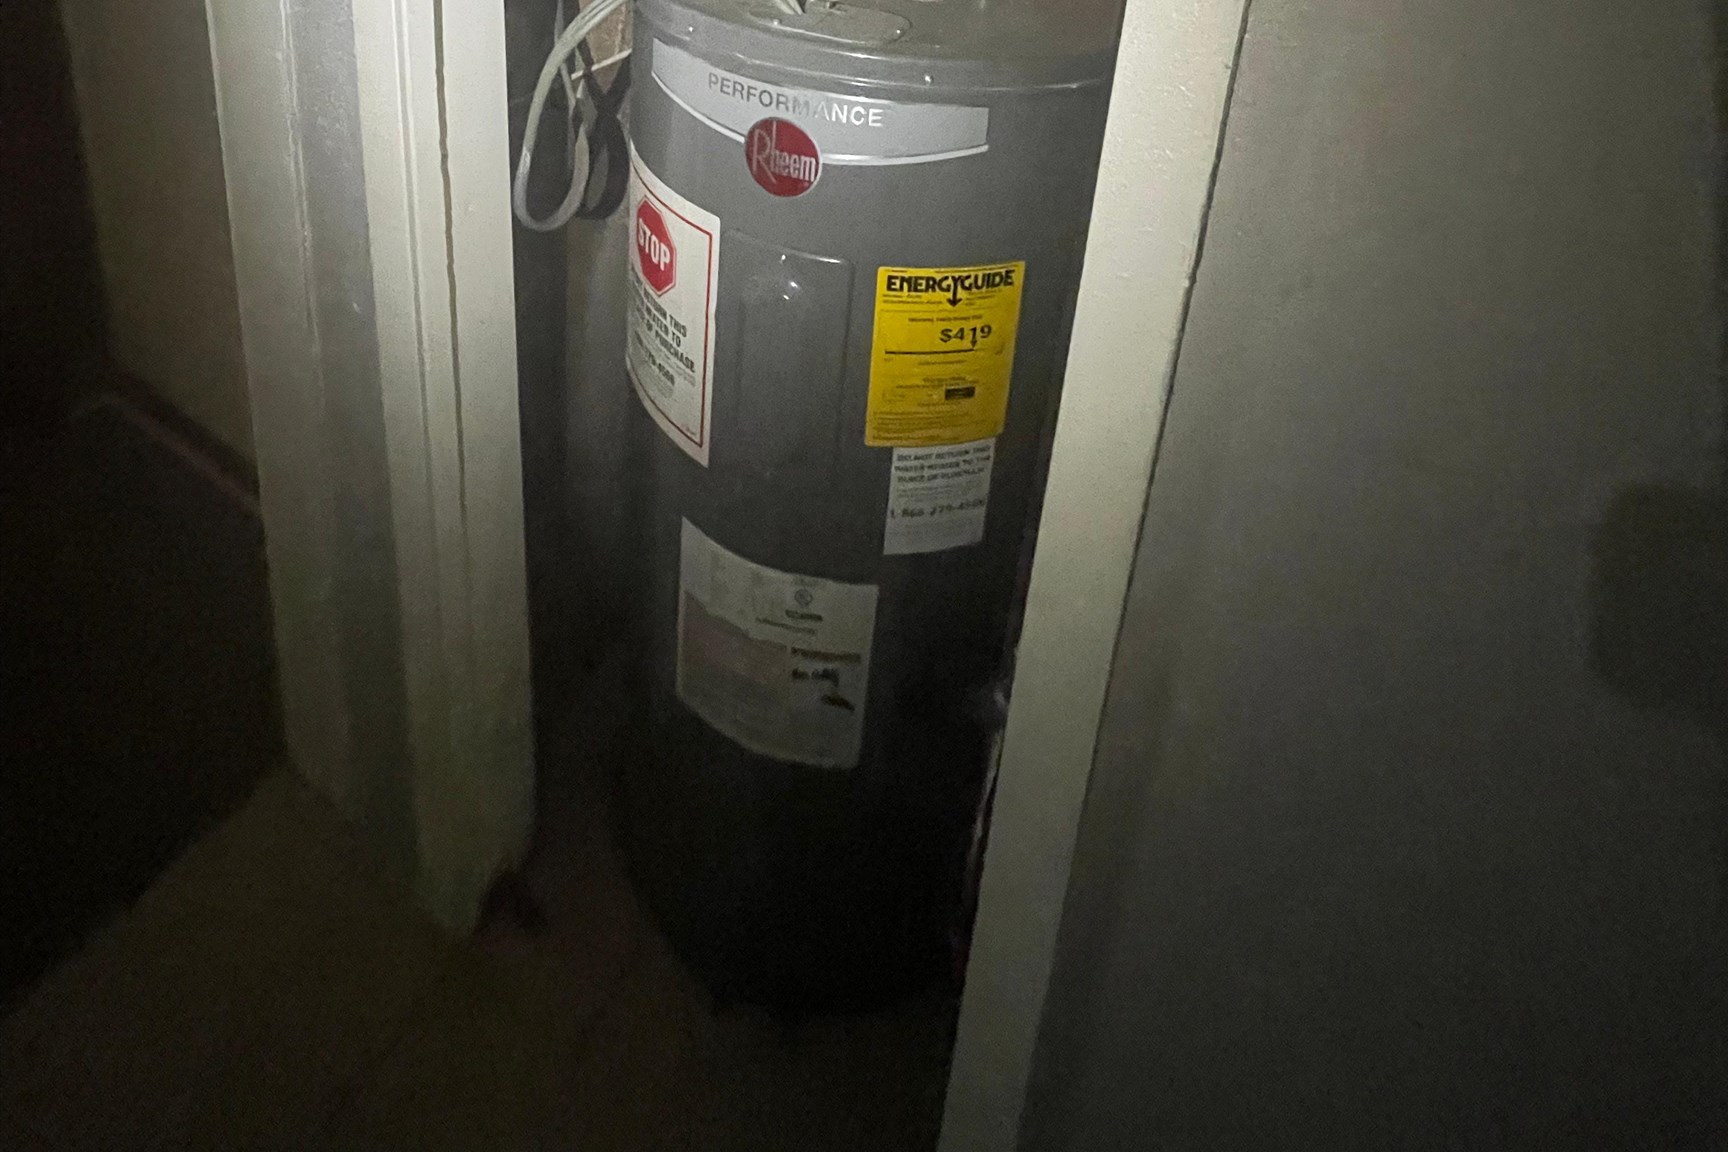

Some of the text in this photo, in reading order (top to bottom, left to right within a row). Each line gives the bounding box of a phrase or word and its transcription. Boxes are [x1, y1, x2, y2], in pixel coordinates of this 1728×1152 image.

[708, 72, 884, 128] PERFORMANCE
[752, 120, 817, 184] Rheem
[638, 217, 671, 272] STOP
[886, 269, 1016, 294] ENERGYGUIDE
